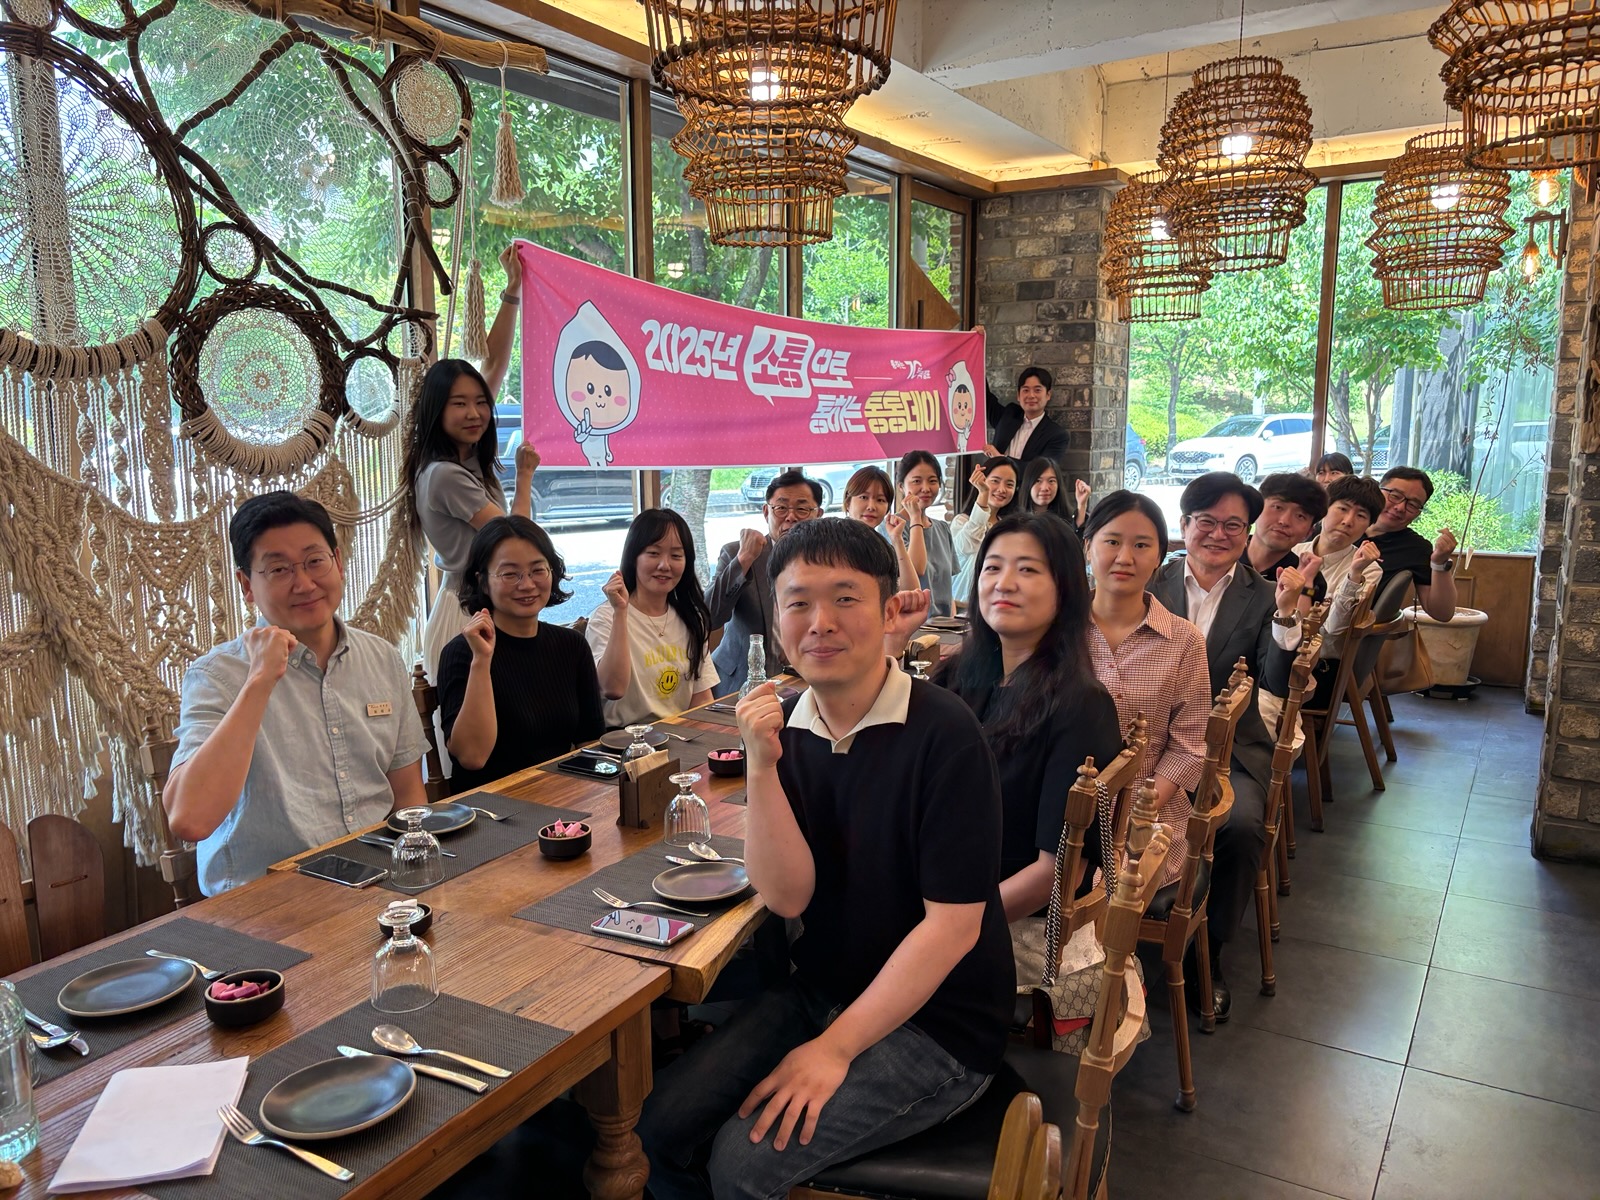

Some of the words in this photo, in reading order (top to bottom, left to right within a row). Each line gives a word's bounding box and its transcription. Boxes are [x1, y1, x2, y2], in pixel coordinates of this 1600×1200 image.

[640, 319, 743, 381] 2025년
[751, 332, 853, 390] 소통으로
[809, 394, 866, 434] 통하는
[864, 390, 941, 434] 통통데이
